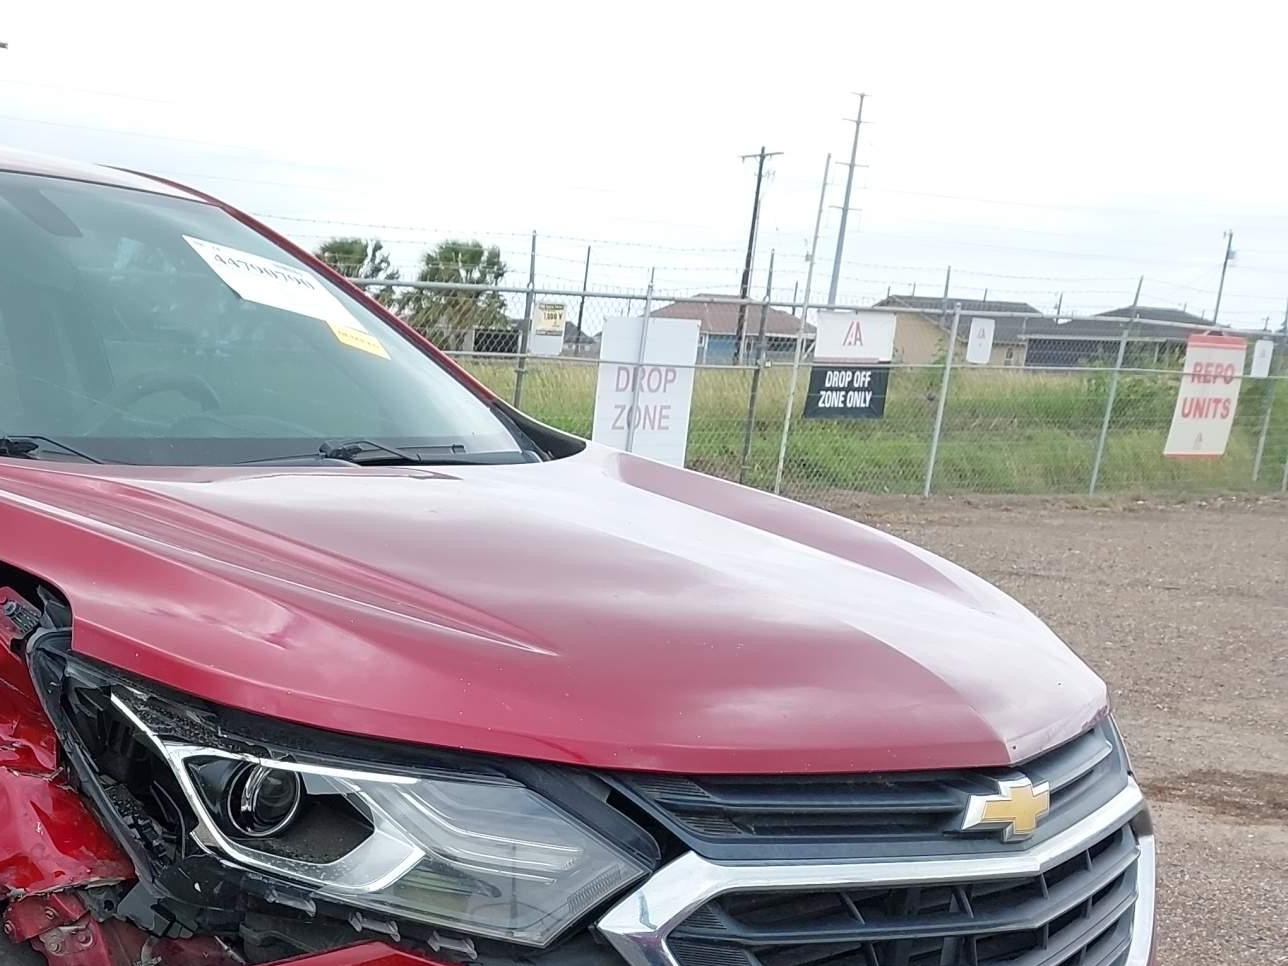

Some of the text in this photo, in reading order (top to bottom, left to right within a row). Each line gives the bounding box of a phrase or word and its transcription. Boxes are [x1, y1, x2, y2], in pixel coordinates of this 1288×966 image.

[615, 366, 678, 393] DROP
[825, 370, 872, 388] DROP OFF
[1191, 361, 1235, 385] REPO
[818, 391, 873, 408] ZONE ONLY
[1181, 396, 1232, 420] UNITS
[611, 404, 672, 431] ZONE
